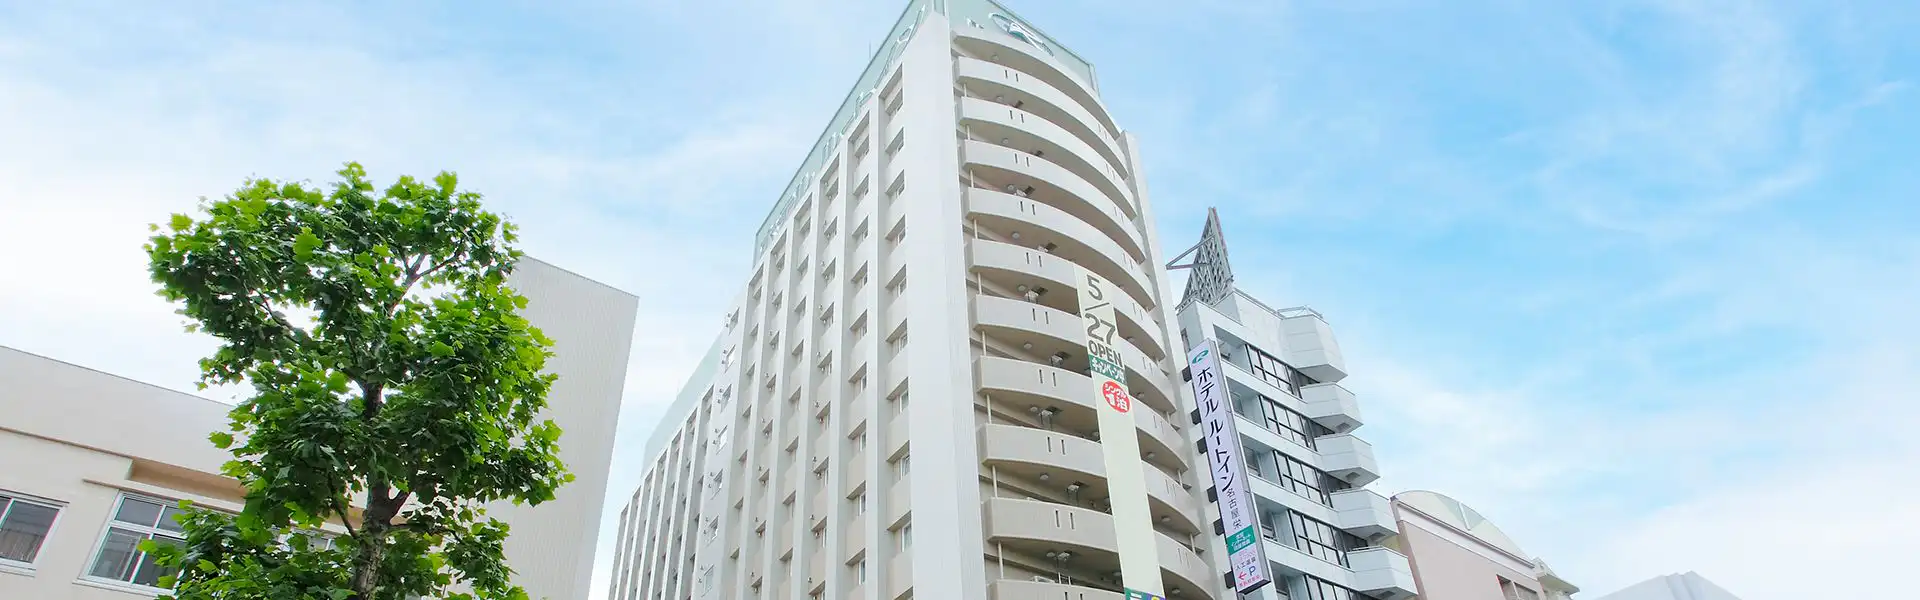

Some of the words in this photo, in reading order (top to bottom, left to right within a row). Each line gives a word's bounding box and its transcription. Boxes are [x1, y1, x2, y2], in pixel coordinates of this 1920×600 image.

[1088, 340, 1124, 369] OPEN
[1198, 366, 1220, 418] ホテル
[1210, 418, 1235, 492] ルートイン
[1248, 565, 1257, 577] P
